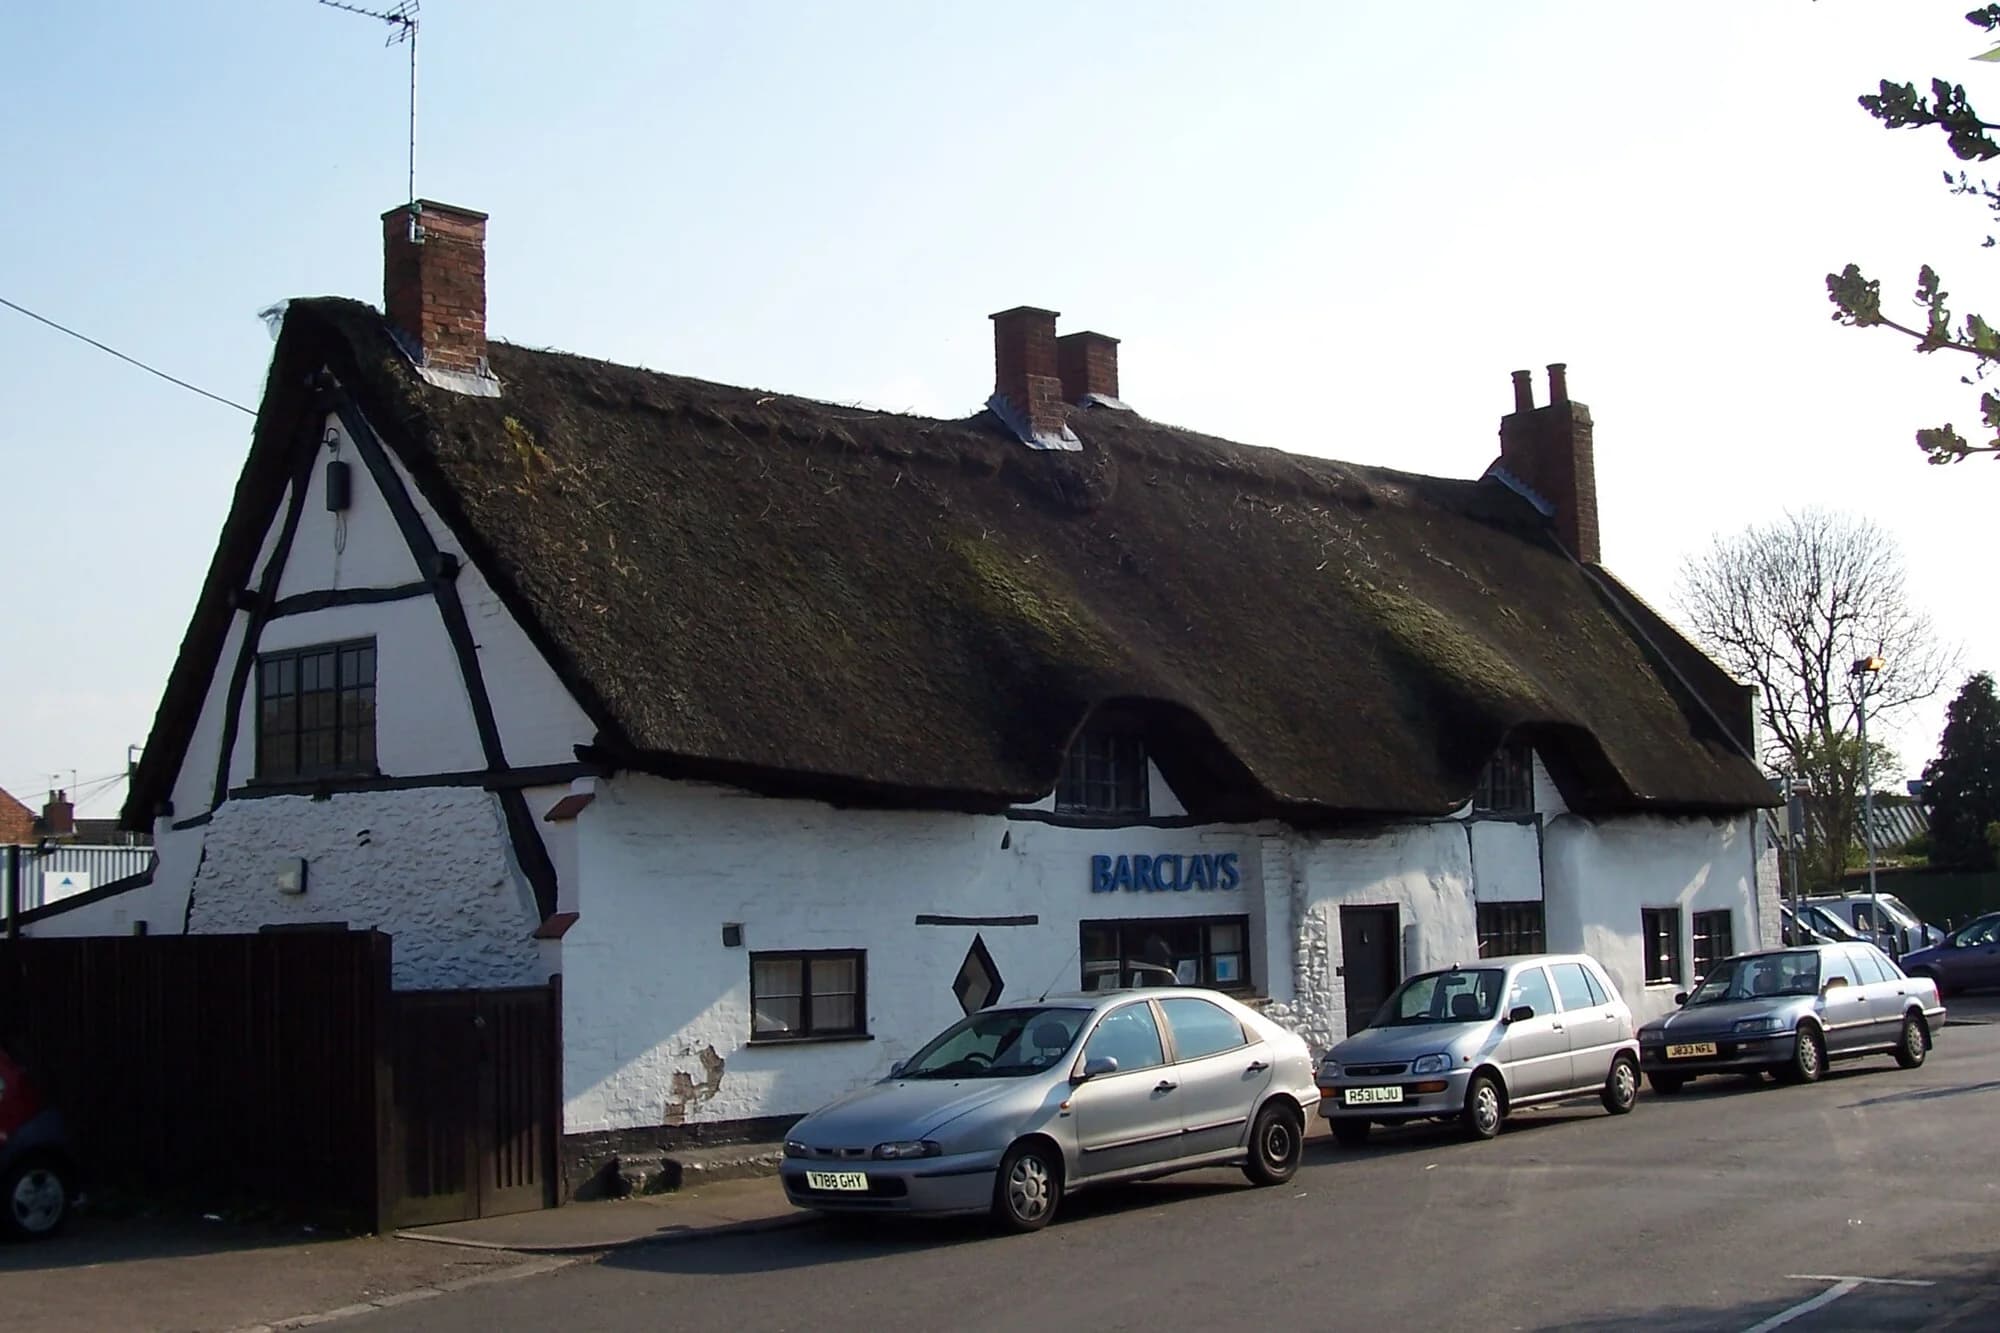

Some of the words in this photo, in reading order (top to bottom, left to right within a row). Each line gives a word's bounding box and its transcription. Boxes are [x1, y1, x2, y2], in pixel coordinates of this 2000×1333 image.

[1091, 853, 1241, 893] BARCLAYS
[1349, 1089, 1374, 1102] R531
[1375, 1087, 1398, 1101] LJU
[839, 1173, 862, 1188] GHY
